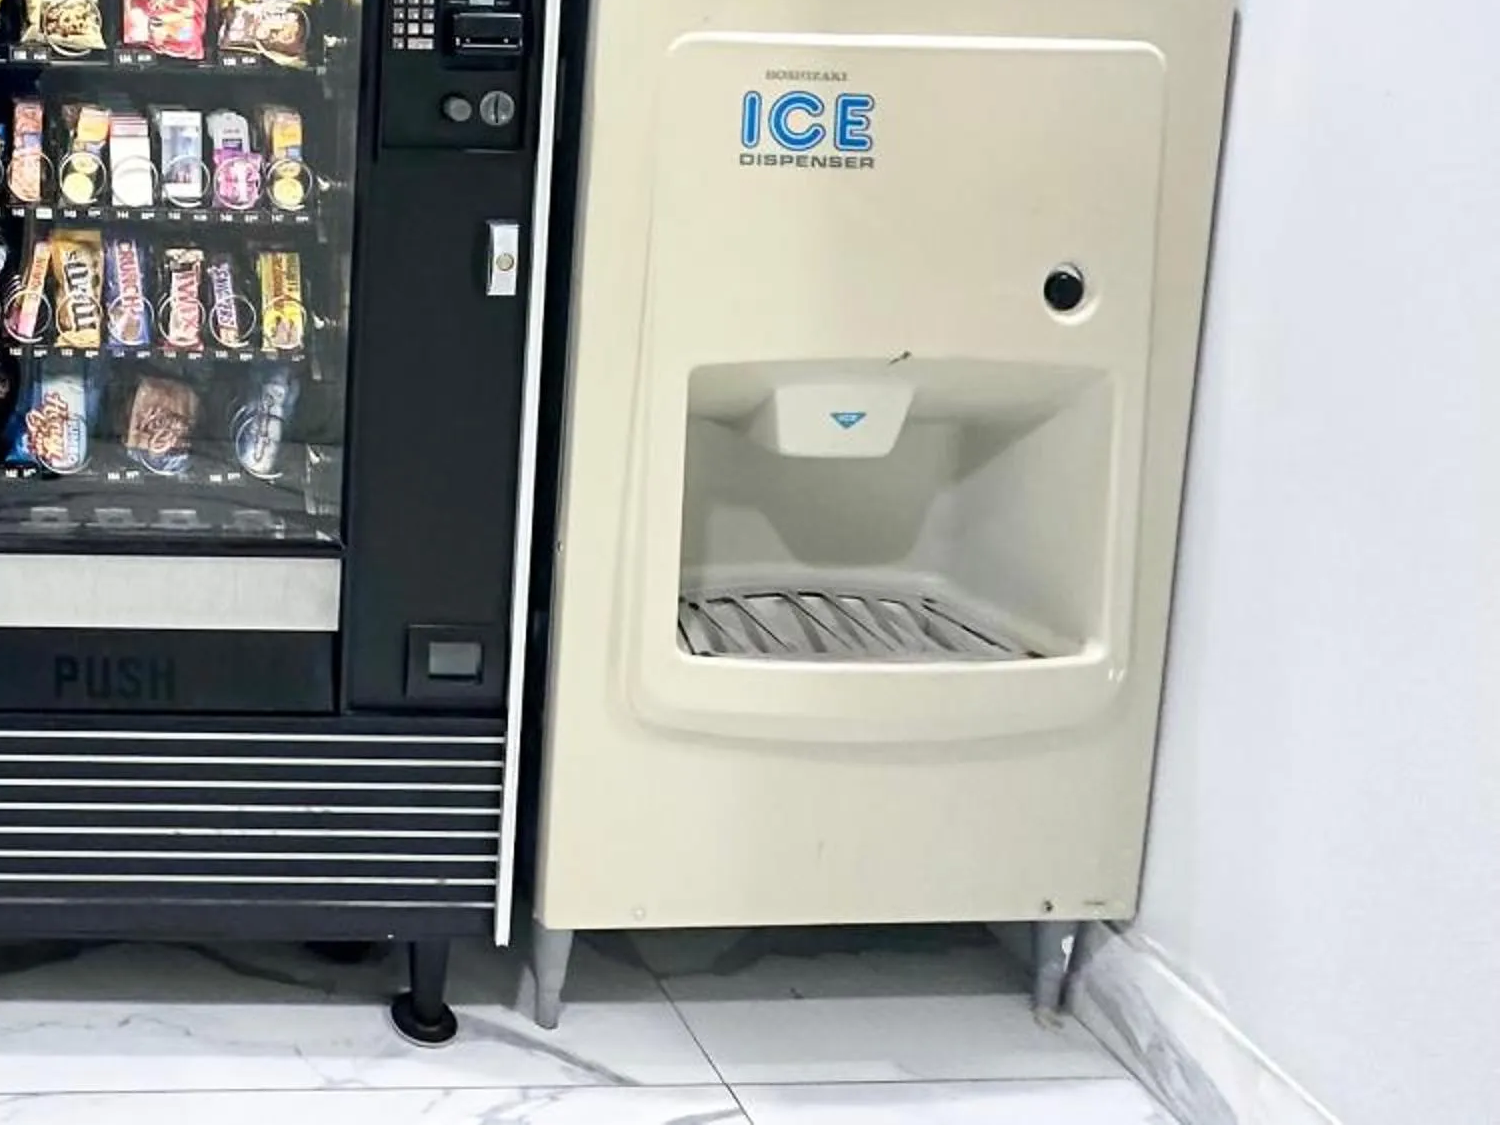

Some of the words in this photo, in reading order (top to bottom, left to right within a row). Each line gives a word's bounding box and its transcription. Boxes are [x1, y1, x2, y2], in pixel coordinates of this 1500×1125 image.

[765, 69, 849, 82] HOSHIZAKI
[741, 90, 875, 152] ICE
[739, 153, 876, 169] DISPENSER
[53, 653, 175, 701] PUSH
